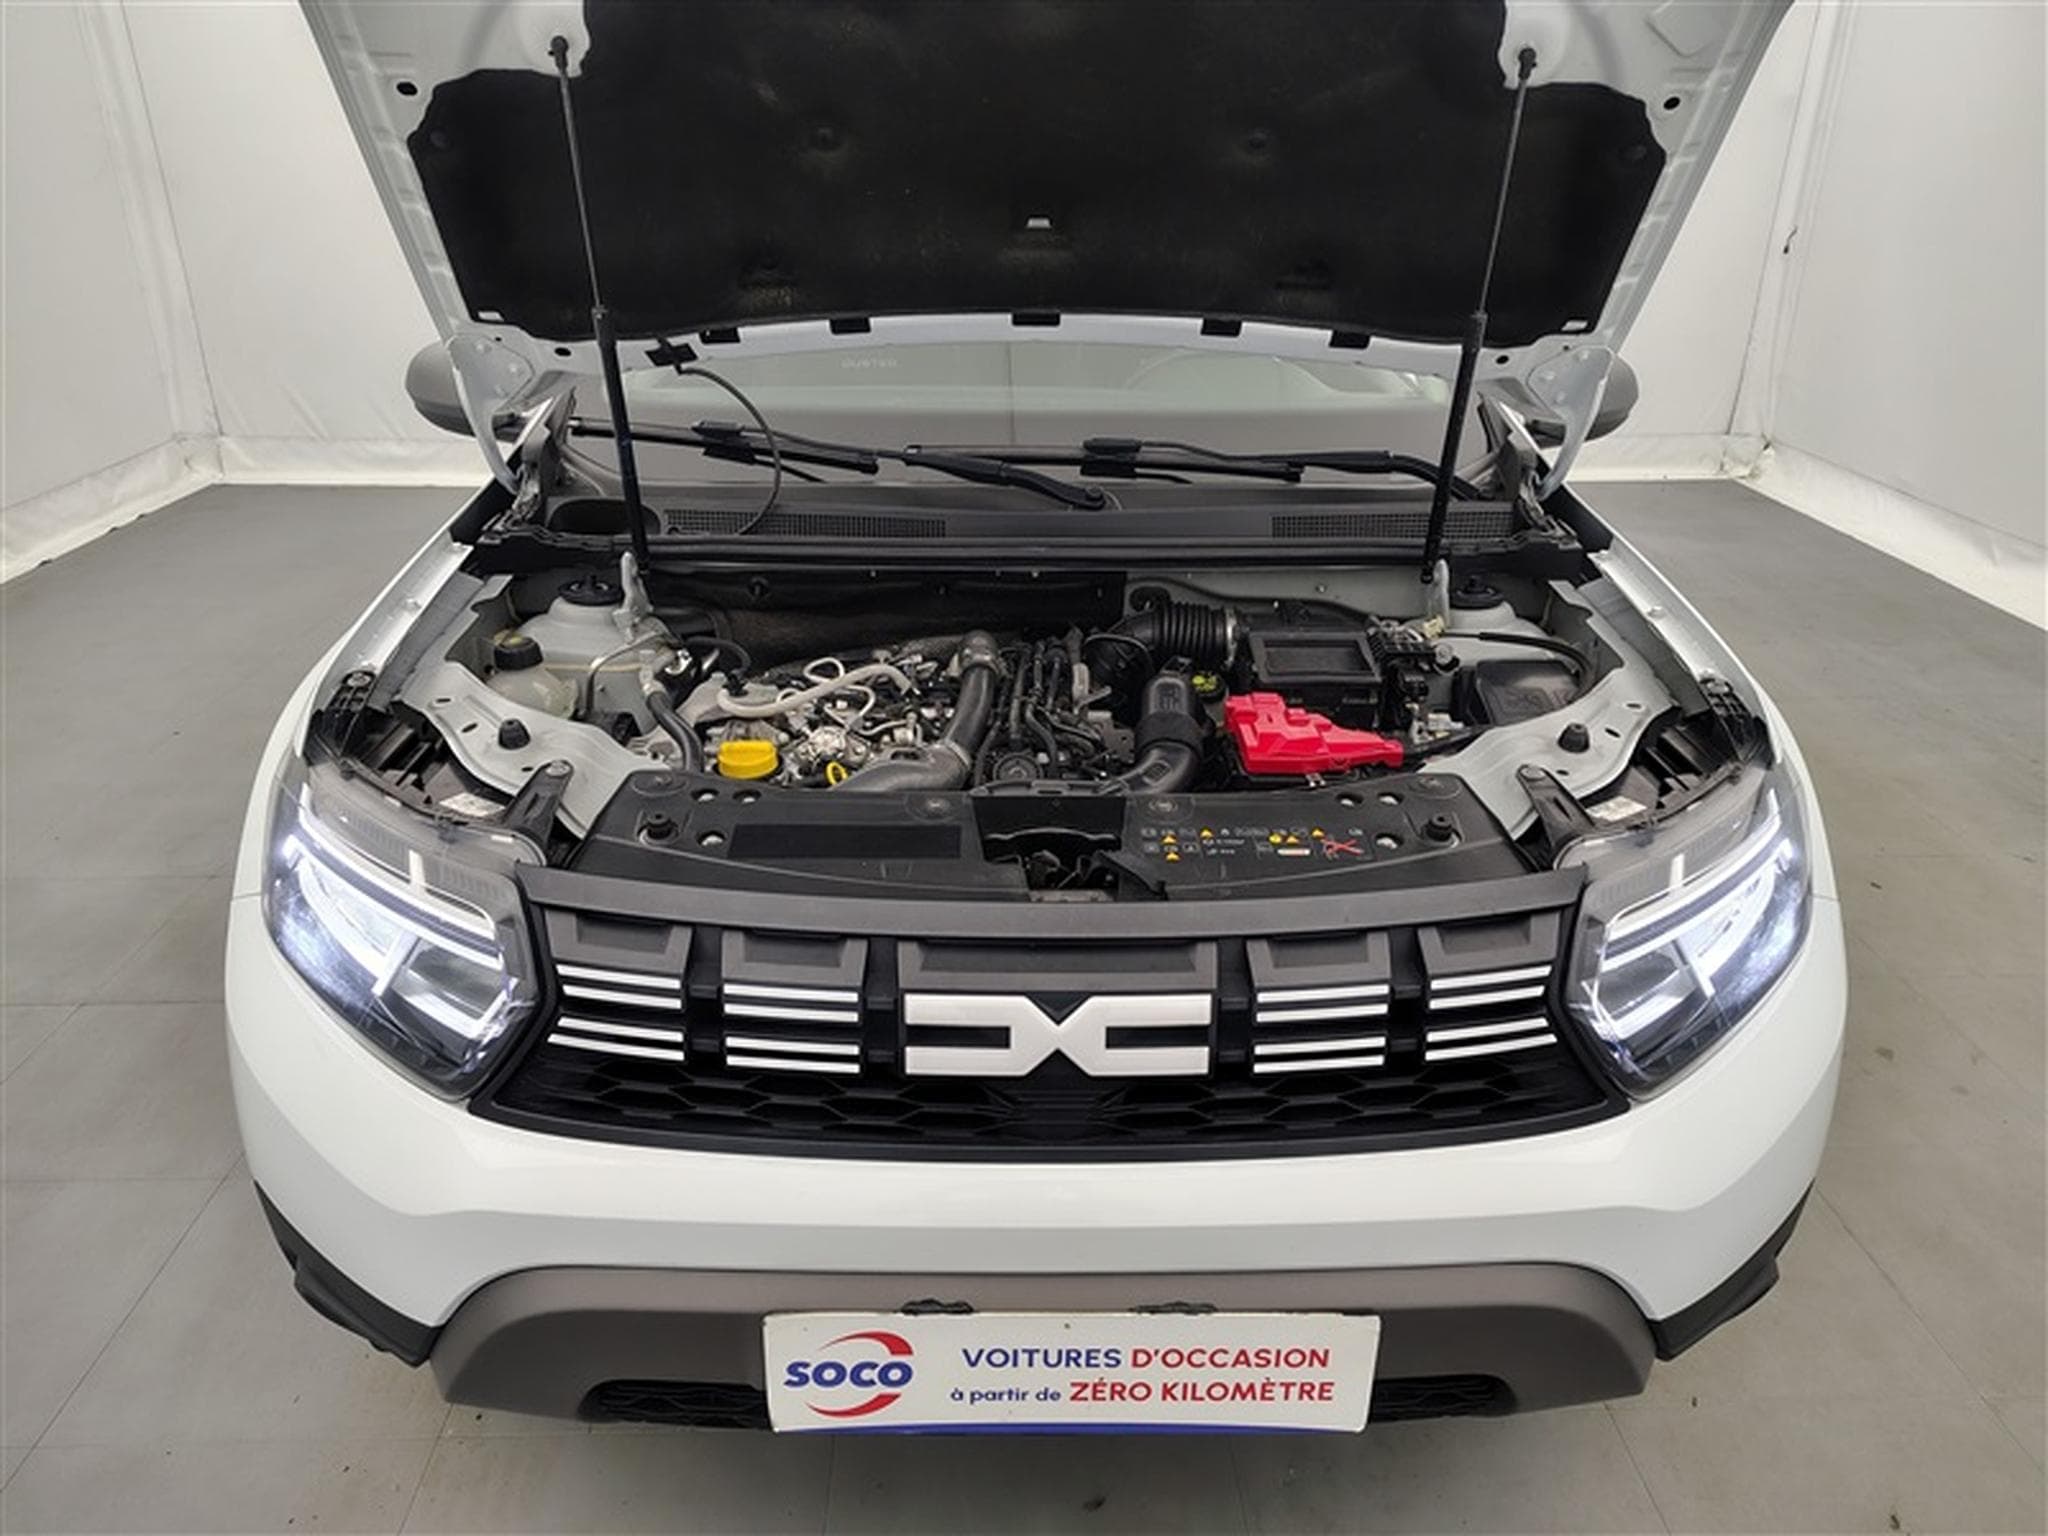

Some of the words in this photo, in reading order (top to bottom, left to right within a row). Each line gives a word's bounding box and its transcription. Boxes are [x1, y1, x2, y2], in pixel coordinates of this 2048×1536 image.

[961, 1348, 1122, 1369] VOITURES
[1131, 1348, 1331, 1369] D'OCCASION
[784, 1361, 914, 1387] SOCO
[950, 1387, 964, 1401] à
[969, 1387, 1030, 1405] partir
[1035, 1387, 1062, 1401] de
[1069, 1377, 1153, 1402] ZÉRO
[1160, 1376, 1336, 1402] KILOMÈTRE
